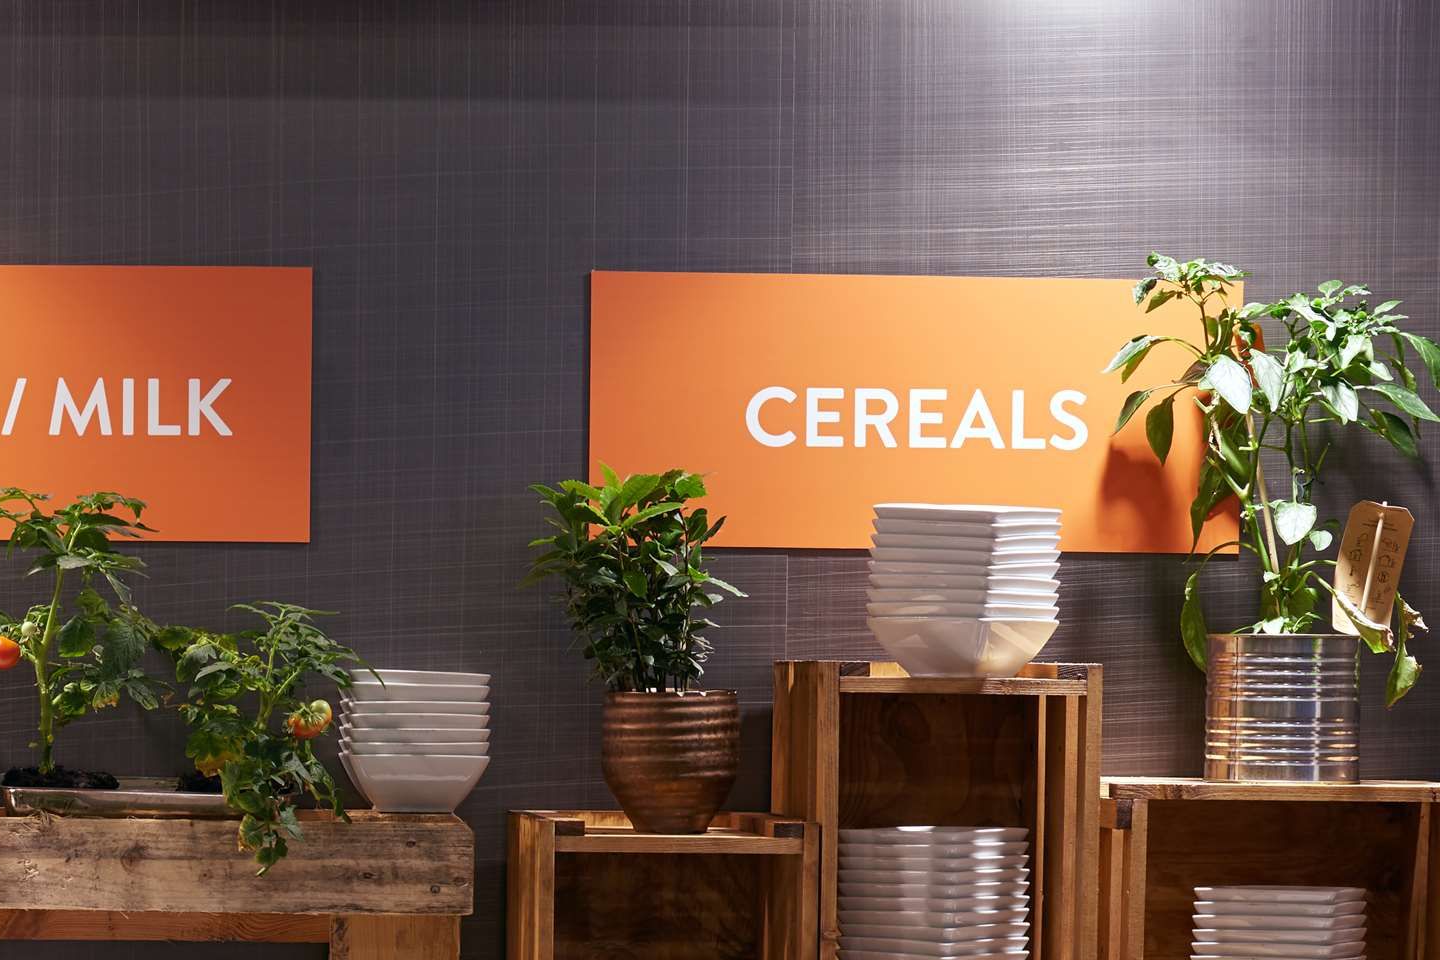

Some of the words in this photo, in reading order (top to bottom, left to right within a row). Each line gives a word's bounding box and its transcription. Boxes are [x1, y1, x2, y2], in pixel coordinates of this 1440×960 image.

[1, 377, 27, 436] /
[48, 377, 233, 436] MILK
[745, 386, 1089, 452] CEREALS
